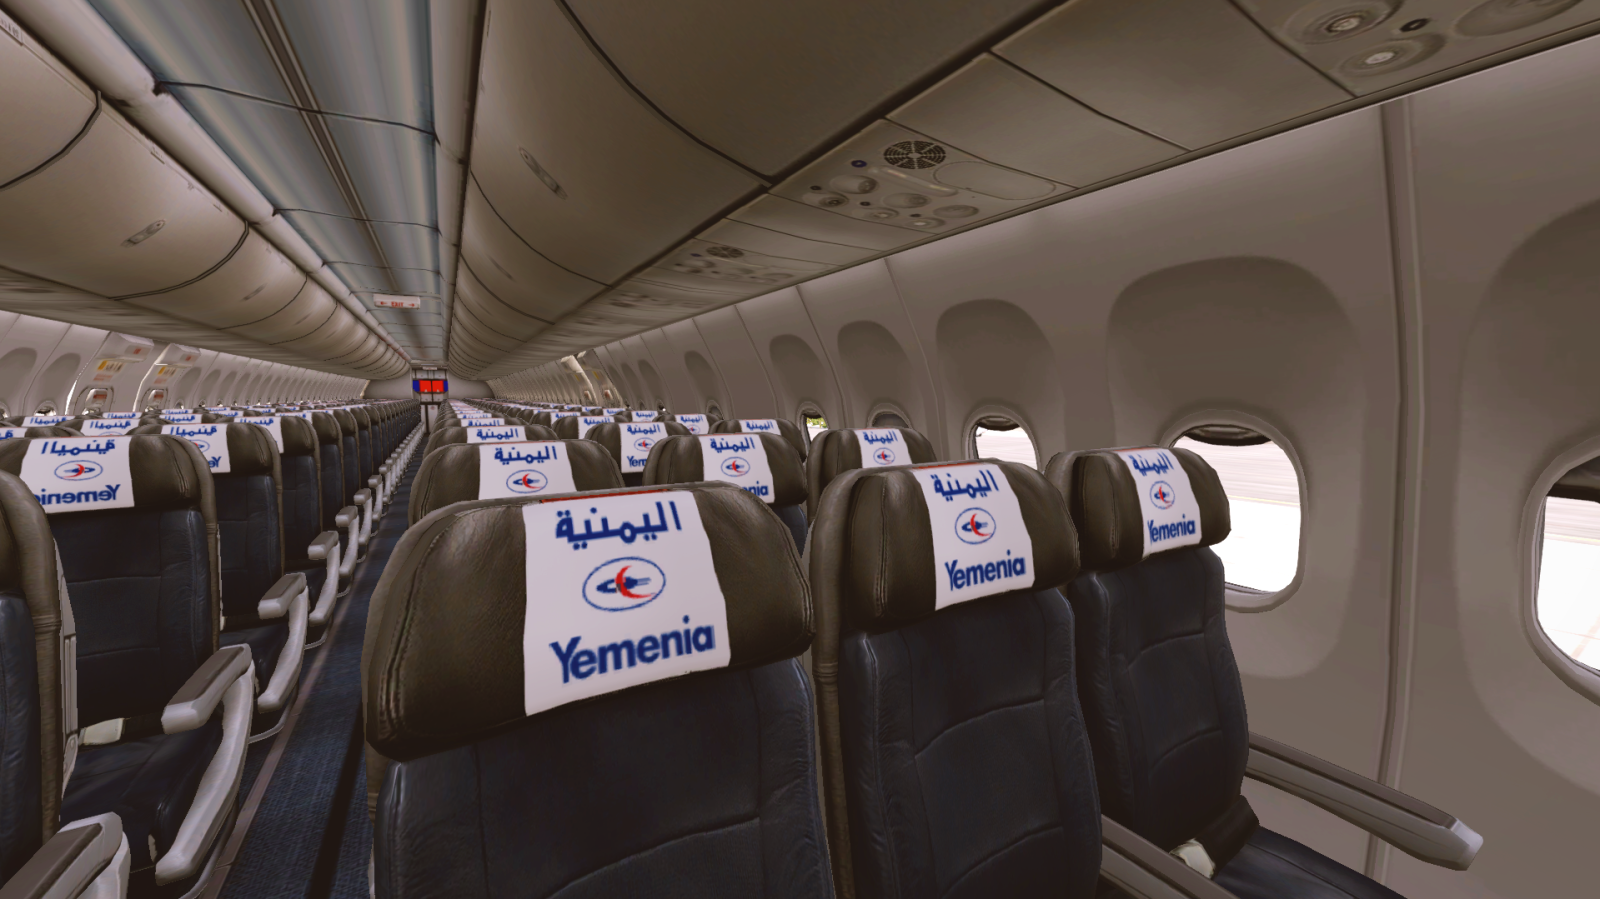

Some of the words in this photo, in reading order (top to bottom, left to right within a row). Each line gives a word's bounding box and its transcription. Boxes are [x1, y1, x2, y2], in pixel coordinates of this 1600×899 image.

[476, 428, 519, 441] اليمنية
[626, 423, 661, 435] اليمنية
[863, 429, 898, 445] اليمنية
[494, 446, 558, 466] اليمنية
[709, 436, 756, 454] اليمنية
[1129, 451, 1174, 477] اليمنية
[930, 469, 1000, 501] اليمنية
[555, 500, 683, 550] اليمنية
[1148, 514, 1196, 543] Yemenia
[945, 550, 1026, 592] Yemenia
[549, 615, 716, 684] Yemenia
